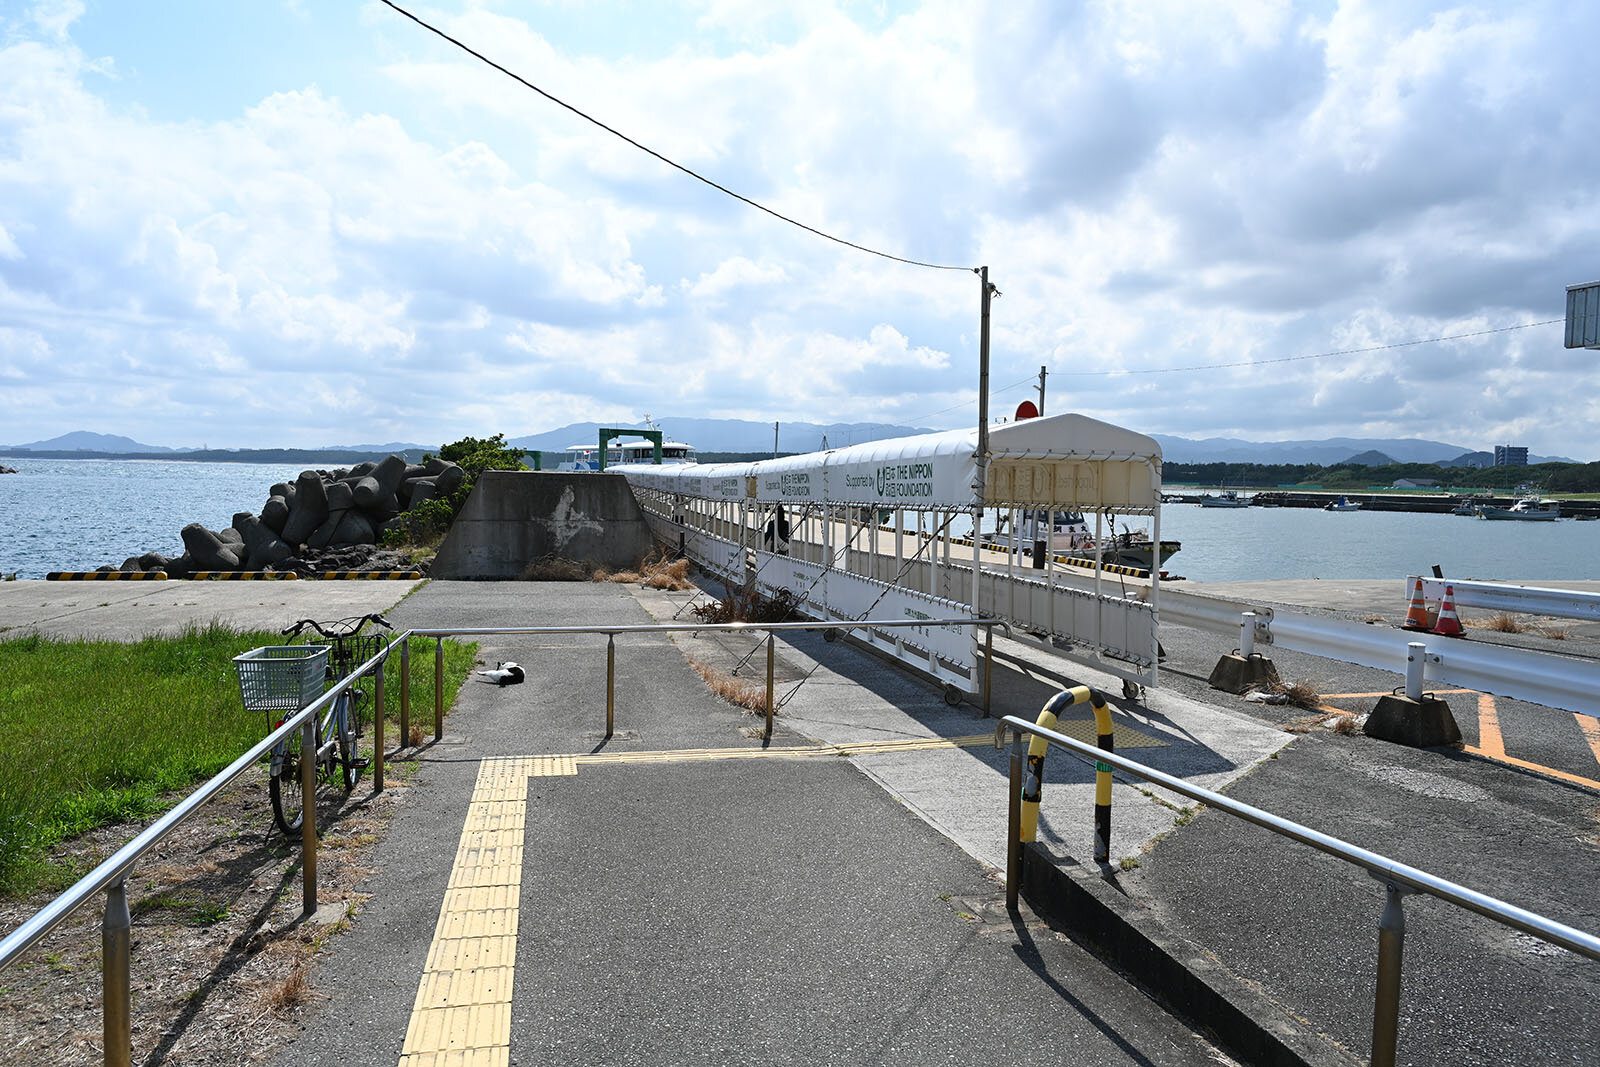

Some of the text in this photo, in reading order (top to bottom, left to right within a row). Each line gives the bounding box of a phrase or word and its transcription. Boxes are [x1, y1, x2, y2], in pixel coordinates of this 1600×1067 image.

[897, 463, 933, 479] THE NIPPON
[846, 474, 875, 490] Supported by
[897, 482, 933, 497] FOUNDATION
